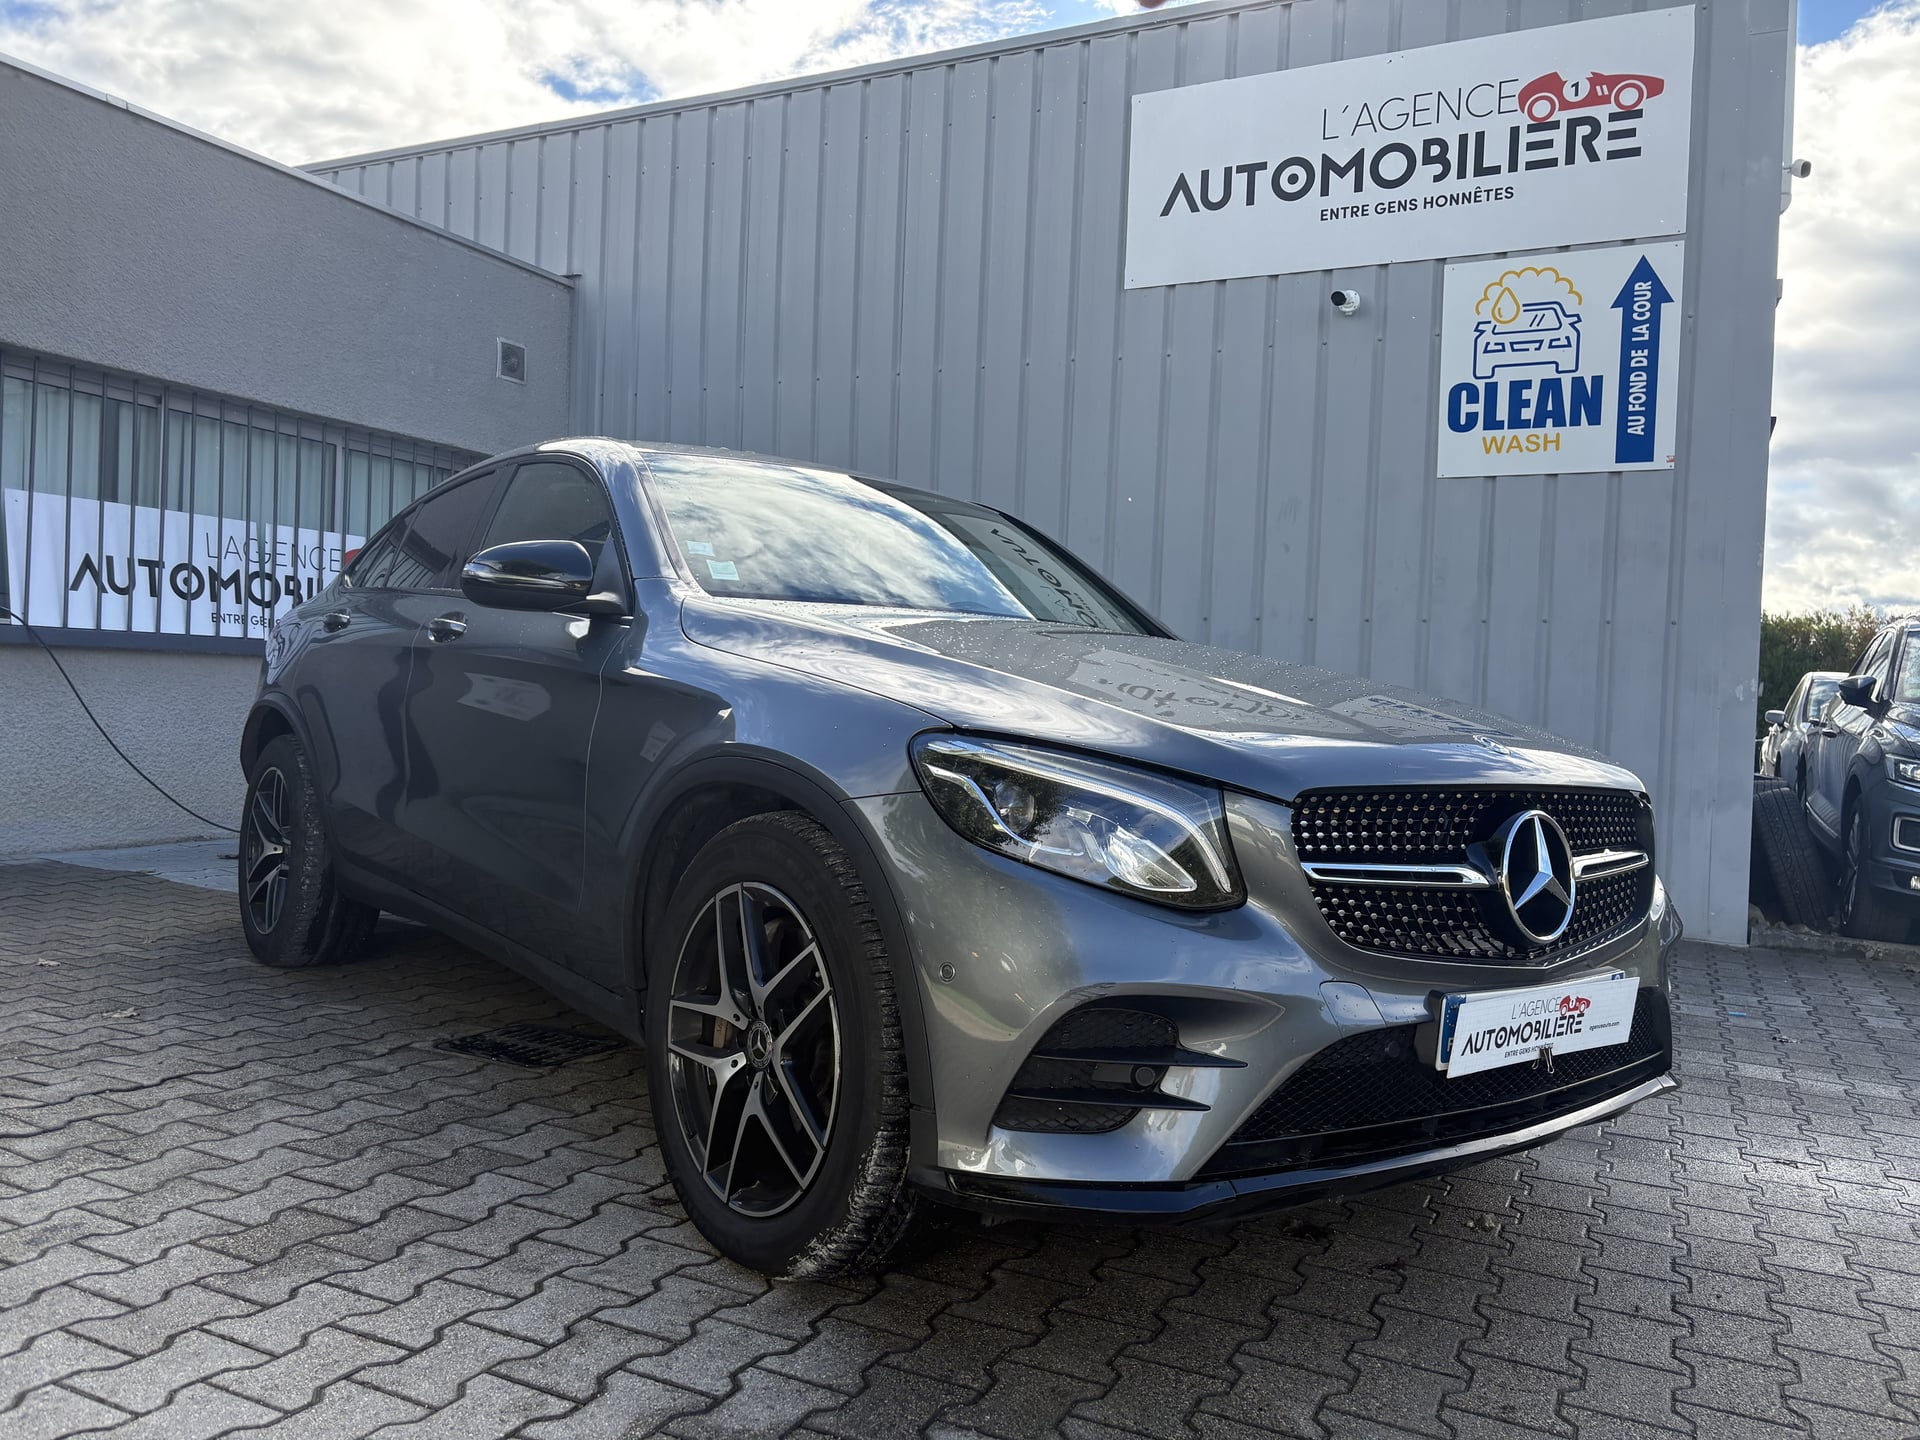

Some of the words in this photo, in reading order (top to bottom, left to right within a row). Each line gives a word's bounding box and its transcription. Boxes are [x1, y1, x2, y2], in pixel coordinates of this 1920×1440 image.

[1571, 81, 1580, 97] 1
[1322, 78, 1519, 140] L'AGENCE
[1160, 109, 1644, 218] AUTOMOBILIERE
[1320, 204, 1370, 221] ENTRE
[1374, 199, 1418, 215] GENS
[1423, 186, 1515, 209] HONNÊTES
[1632, 281, 1652, 321] COUR
[1632, 323, 1650, 341] LA
[1630, 349, 1649, 367] DE
[1447, 375, 1603, 433] CLEAN
[1628, 371, 1647, 412] FOND
[1627, 415, 1645, 435] AU
[1482, 433, 1561, 455] WASH
[1511, 996, 1561, 1020] L'AGENCE
